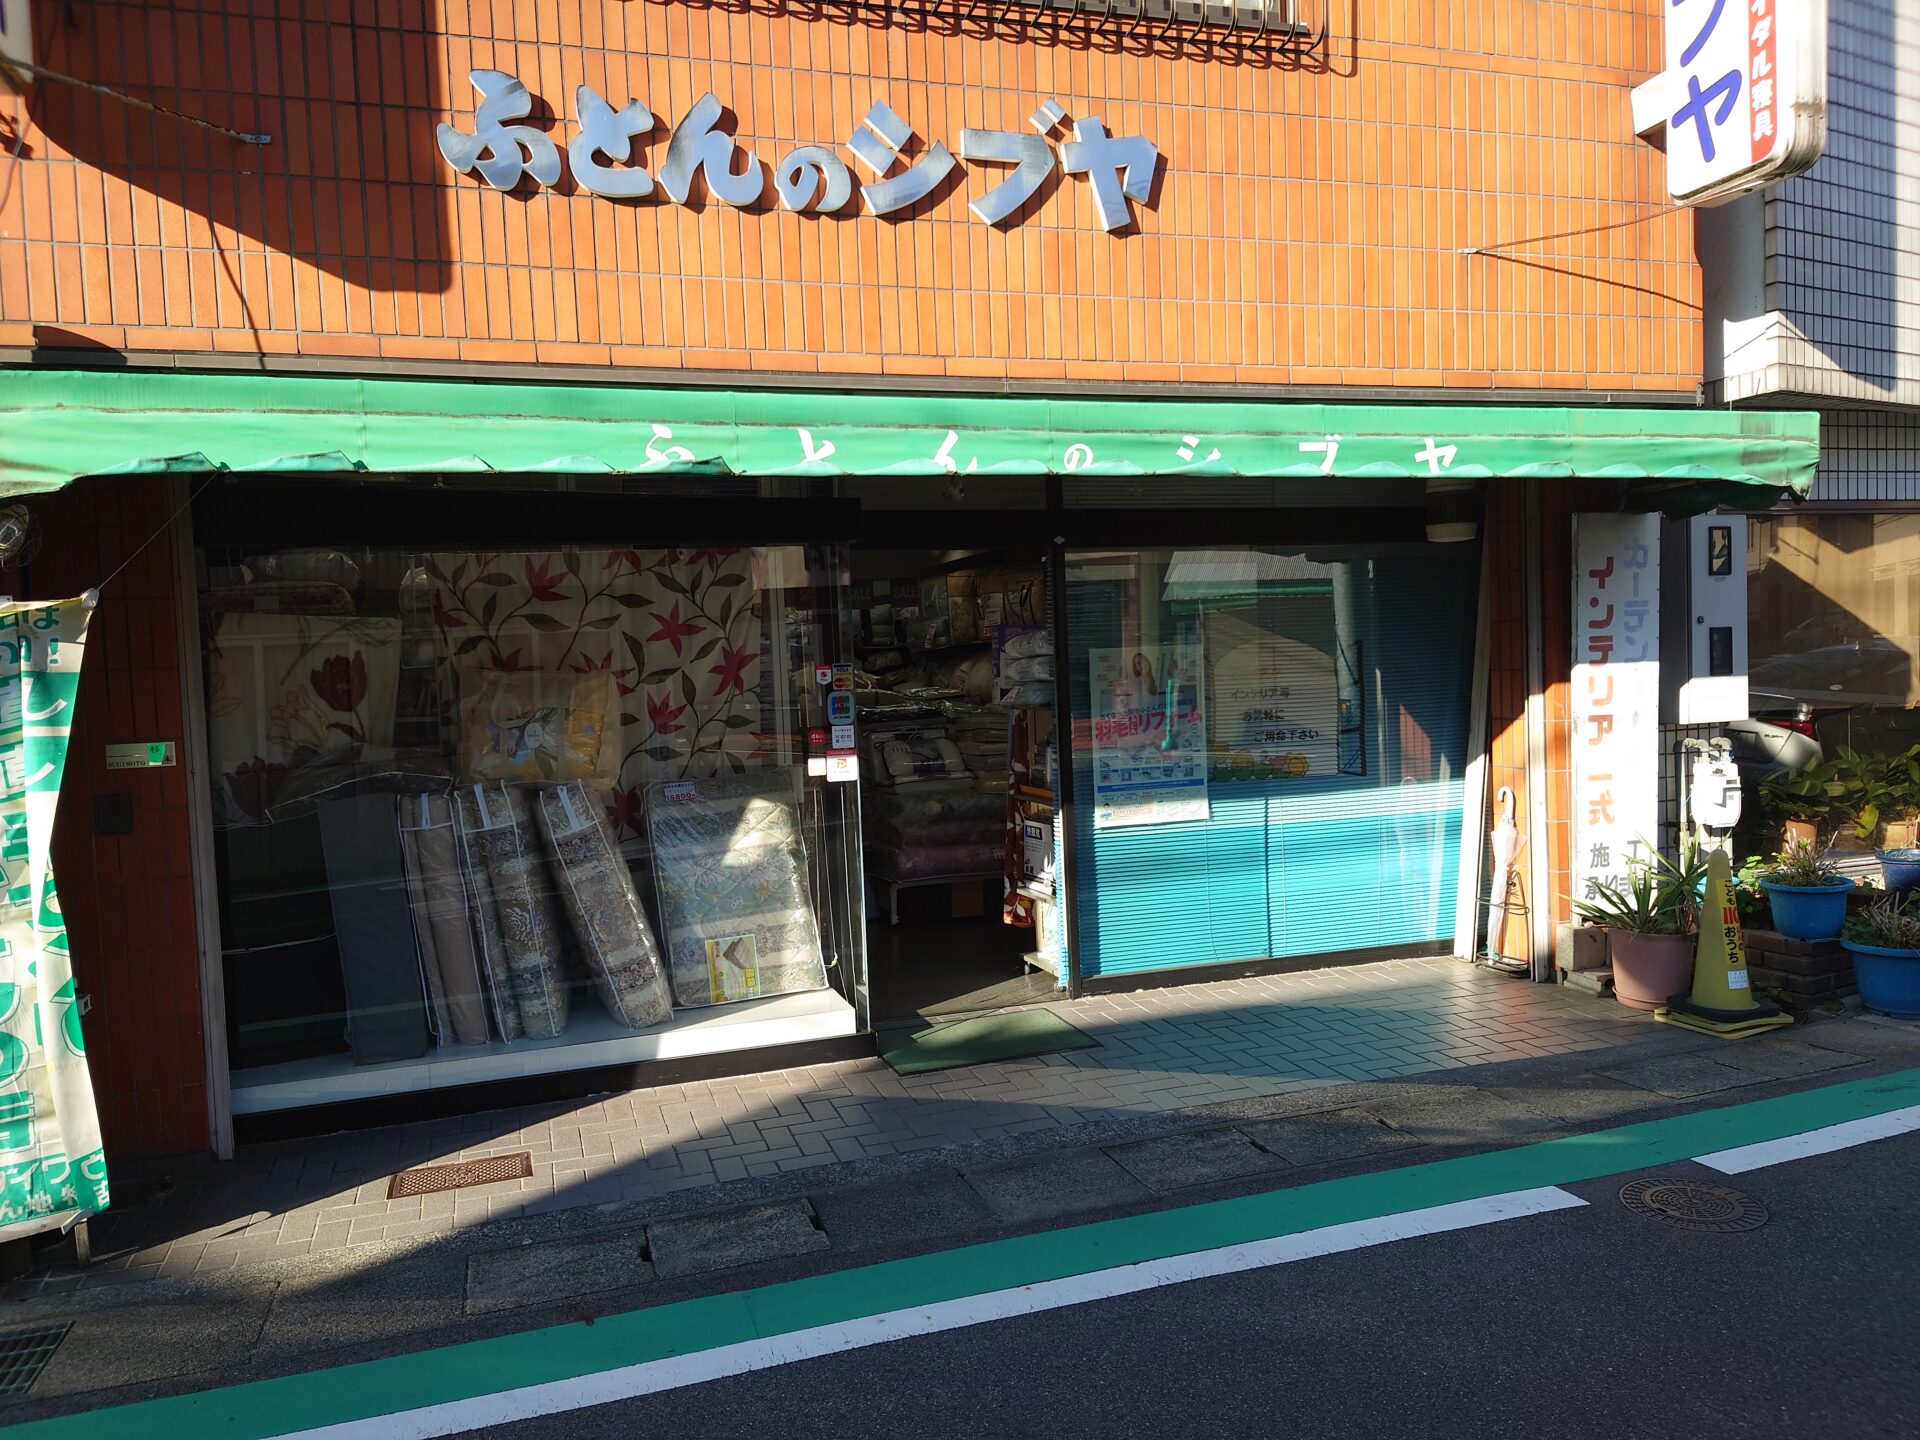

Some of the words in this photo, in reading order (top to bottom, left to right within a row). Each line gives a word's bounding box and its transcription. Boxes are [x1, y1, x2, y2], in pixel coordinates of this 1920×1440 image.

[436, 69, 1159, 233] ふとんのシブヤ
